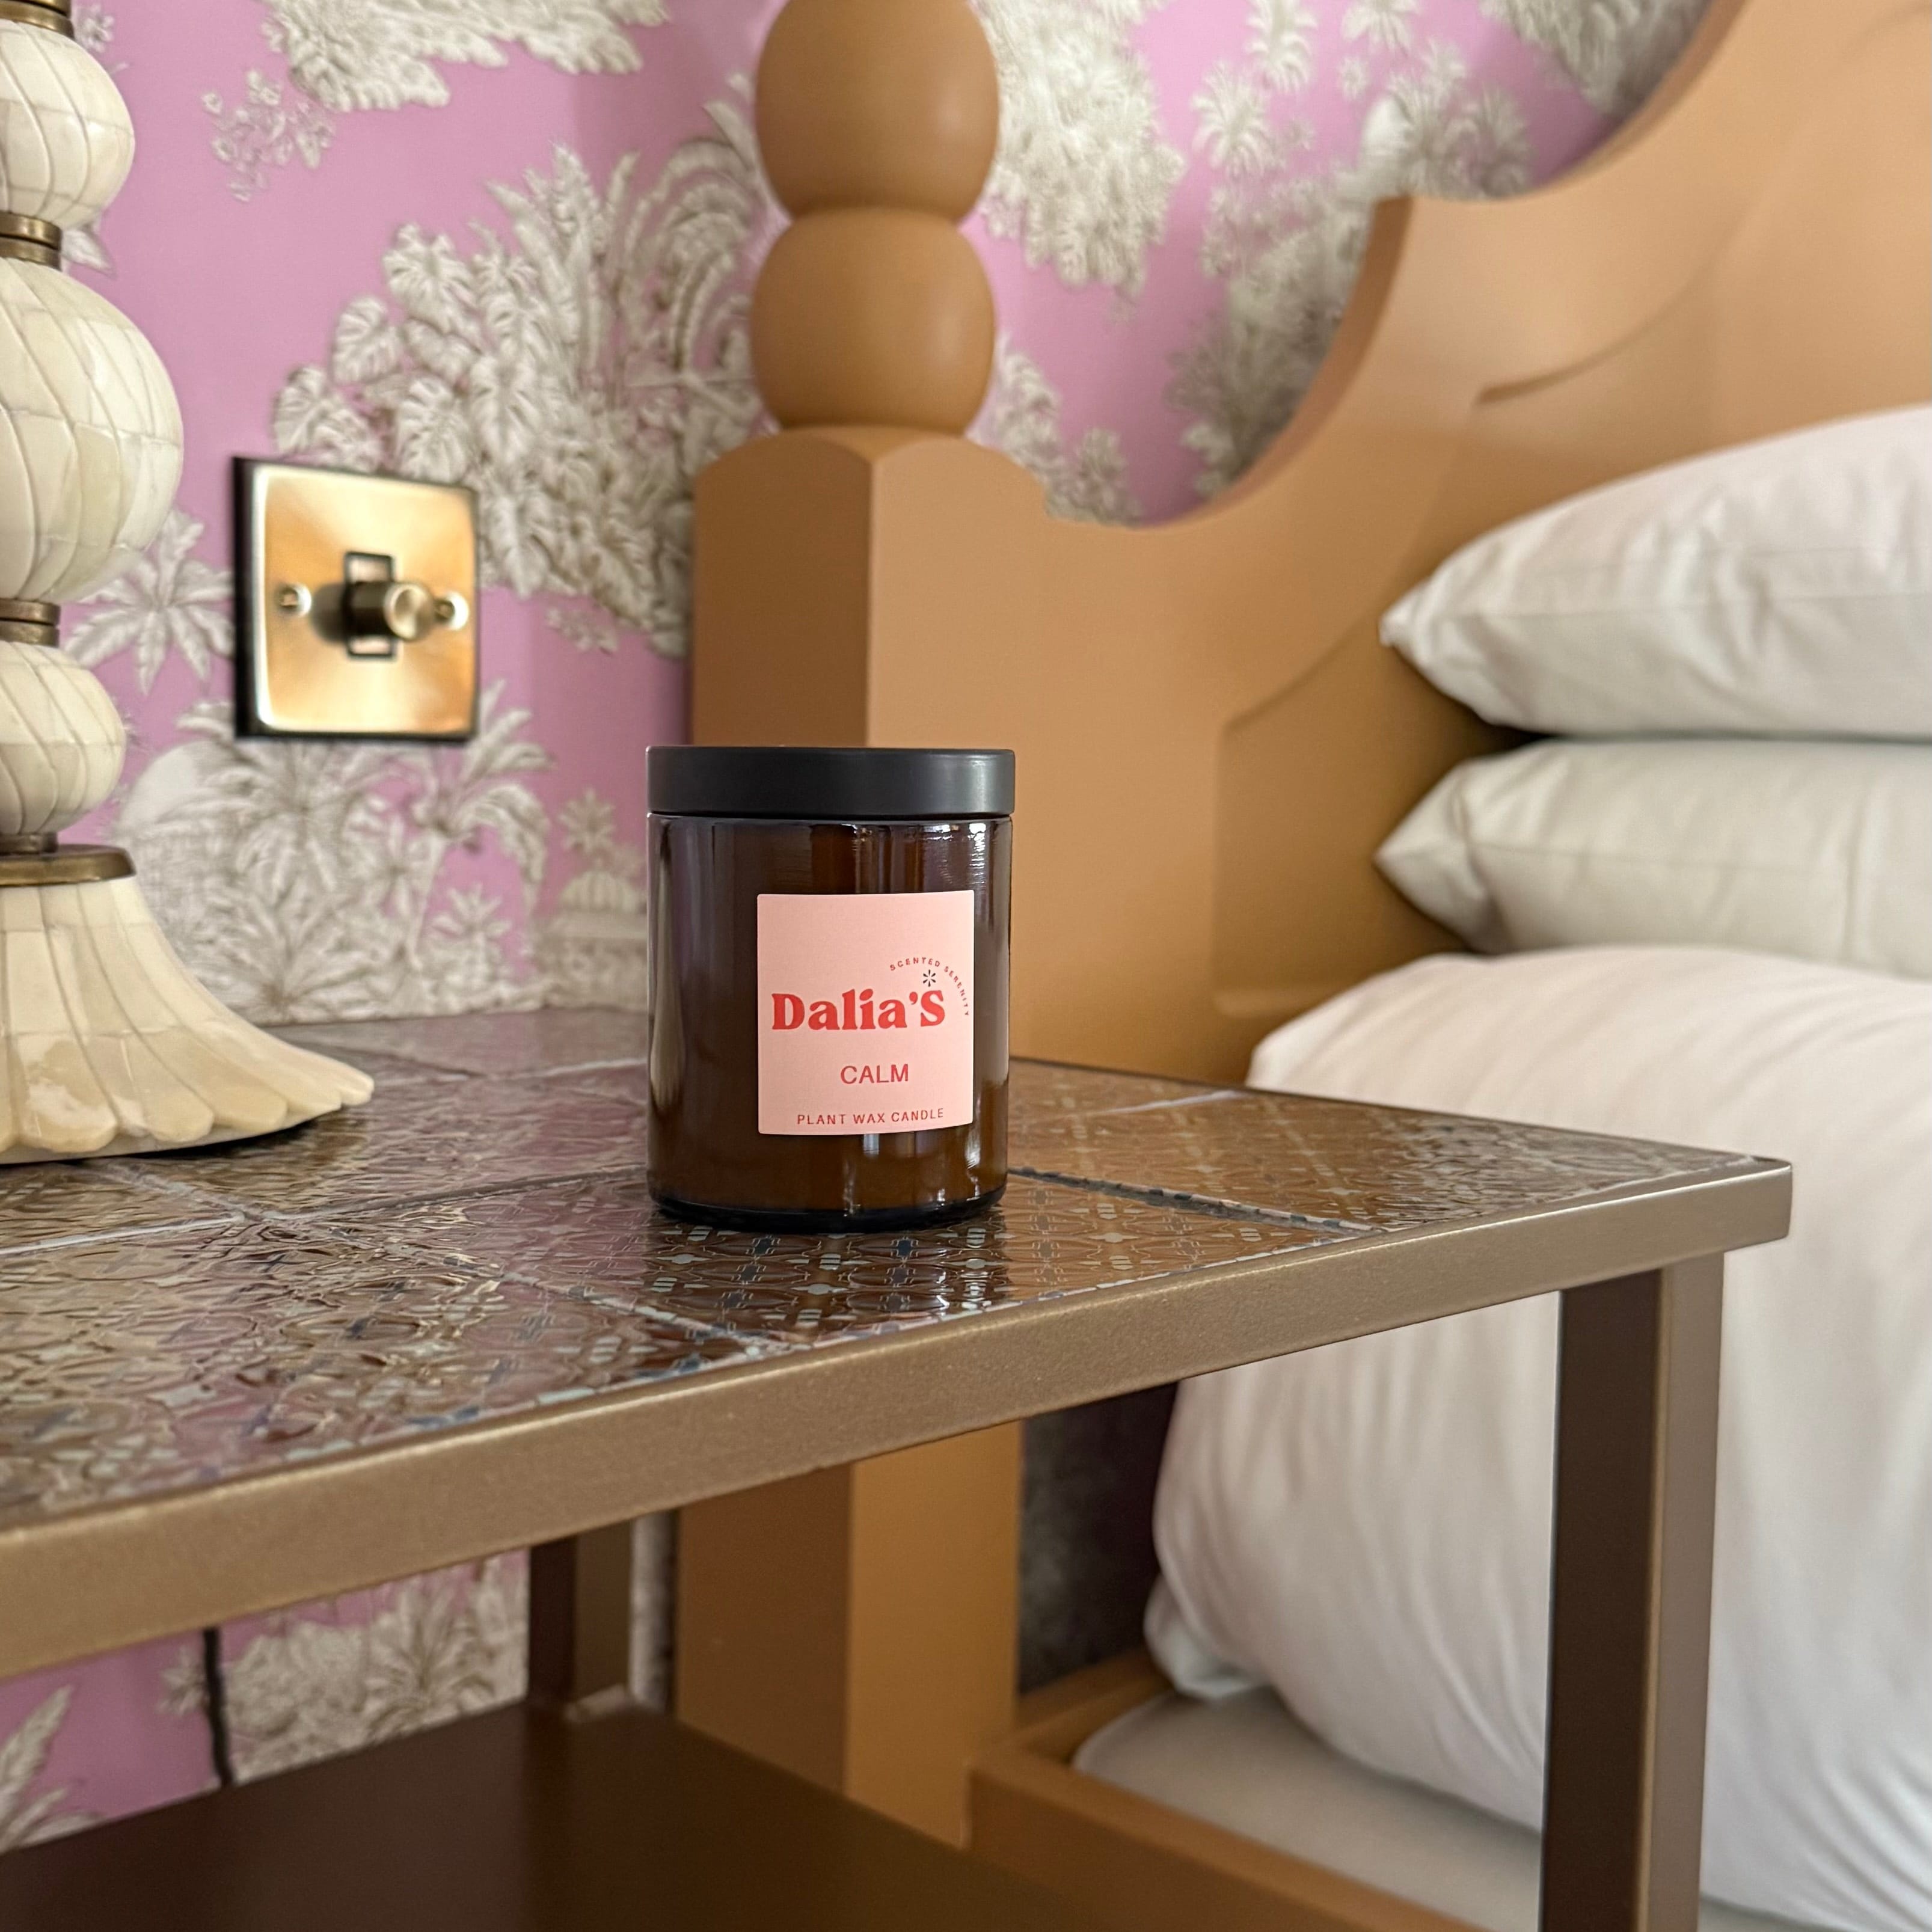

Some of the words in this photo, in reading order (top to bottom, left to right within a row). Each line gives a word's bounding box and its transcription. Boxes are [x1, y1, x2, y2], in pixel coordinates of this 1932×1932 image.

[890, 957, 940, 971] SCENTED
[944, 966, 969, 1016] SERENITY
[841, 1064, 909, 1084] CALM
[797, 1114, 846, 1124] PLANT
[853, 1114, 885, 1124] WAX
[891, 1108, 943, 1123] CANDLE
